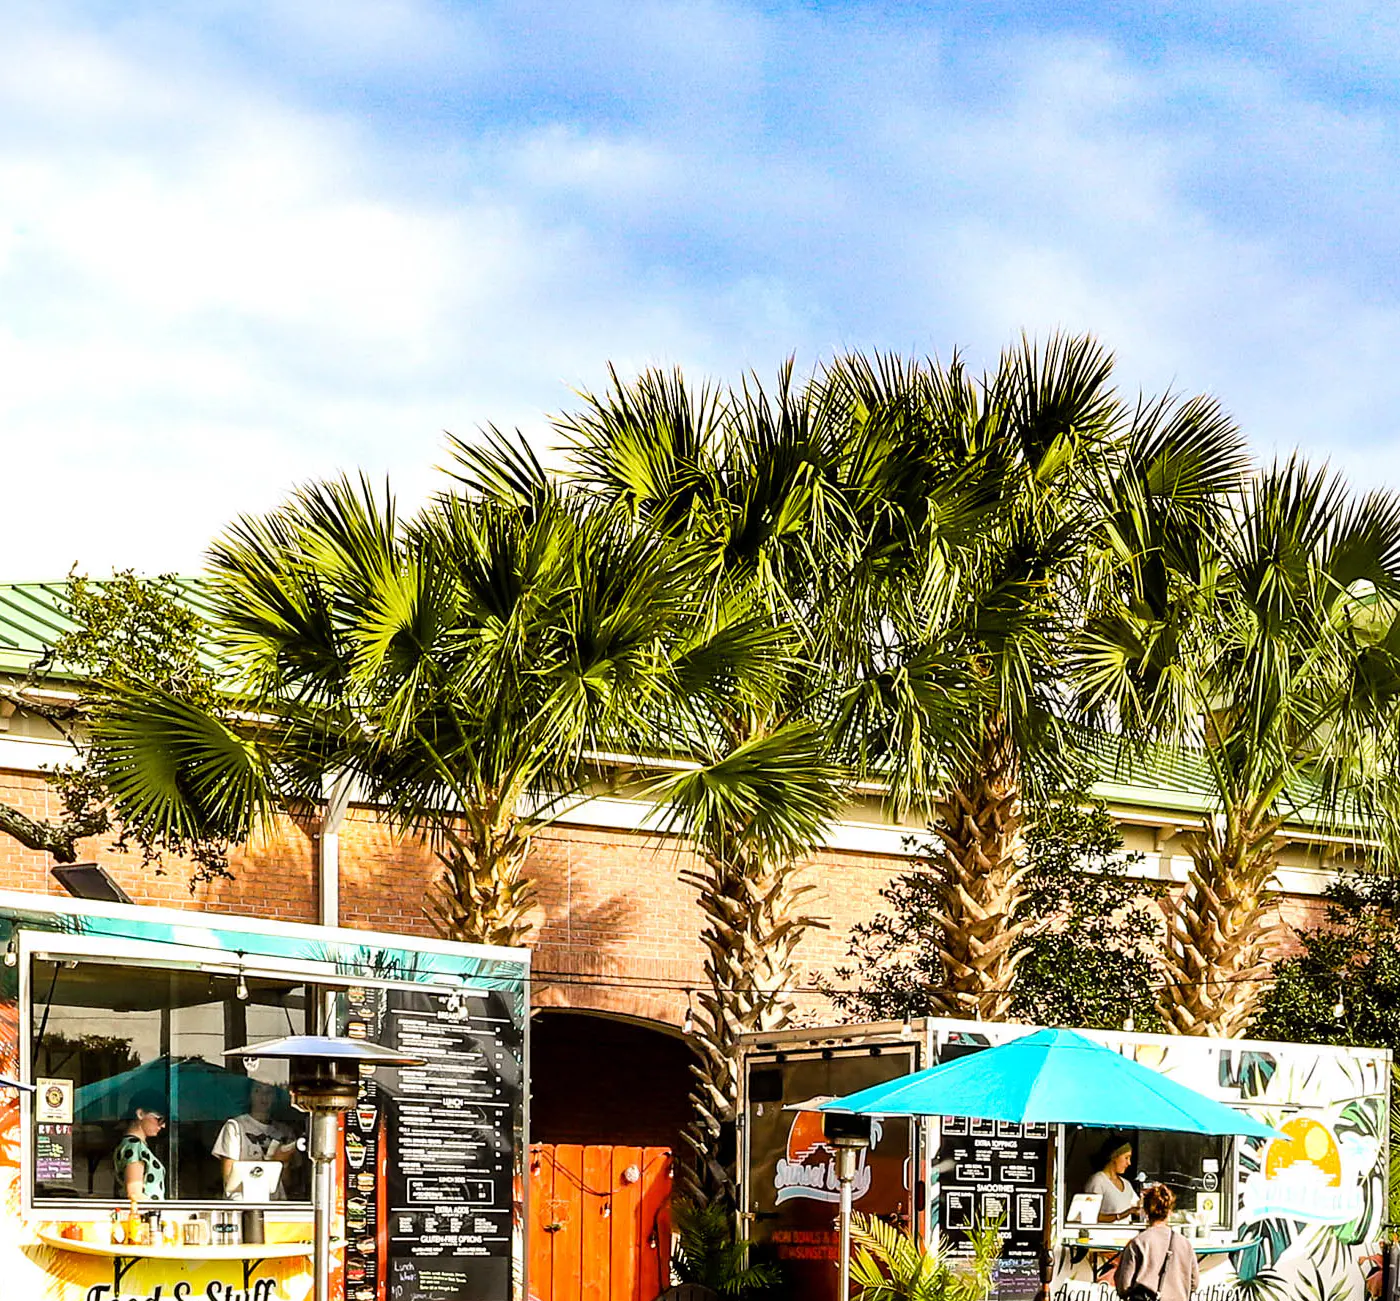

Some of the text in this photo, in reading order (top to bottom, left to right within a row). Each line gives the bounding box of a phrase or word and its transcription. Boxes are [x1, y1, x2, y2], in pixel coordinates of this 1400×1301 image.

[992, 1140, 1018, 1149] TOPPINGS
[774, 1159, 826, 1188] Sunset
[976, 1184, 1014, 1193] SMOOTHIES
[394, 1261, 415, 1272] Lunch
